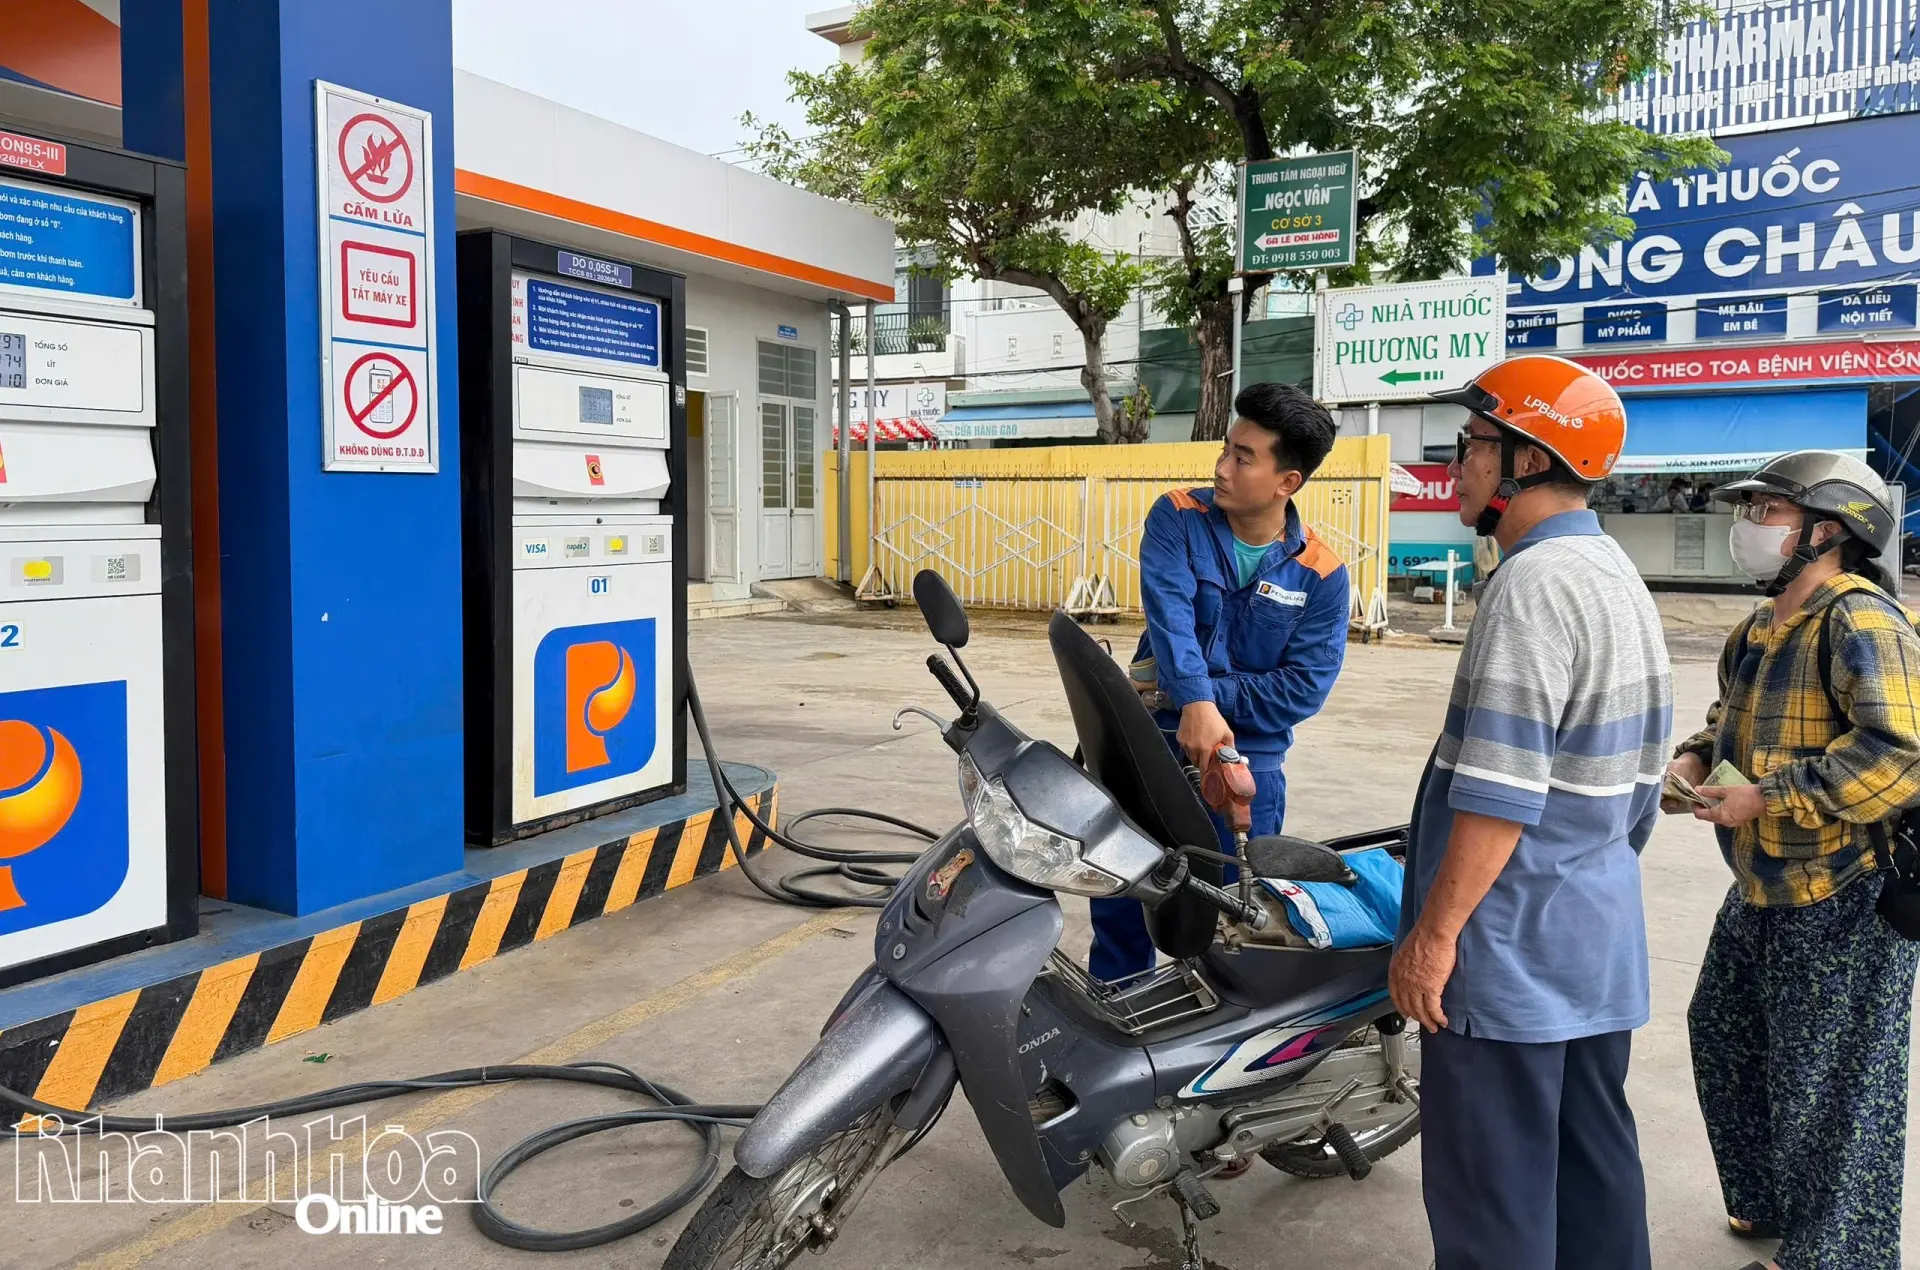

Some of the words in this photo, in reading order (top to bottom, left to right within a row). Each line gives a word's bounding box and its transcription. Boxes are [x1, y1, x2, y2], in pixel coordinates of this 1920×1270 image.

[1666, 15, 1834, 73] PHARMA
[1653, 86, 1722, 116] thuốc
[1794, 64, 1865, 99] ngoại
[0, 137, 58, 160] ON95-III
[1252, 172, 1278, 185] TRUNG
[1280, 169, 1298, 181] TÂM
[1300, 165, 1325, 180] NGOẠI
[1673, 147, 1840, 208] THUỐC
[1265, 190, 1301, 214] NGỌC
[1304, 184, 1330, 206] VÂN
[9, 195, 18, 204] và
[19, 196, 31, 206] xác
[32, 199, 49, 210] nhận
[49, 202, 62, 211] nhu
[63, 203, 75, 214] cầu
[76, 206, 88, 216] của
[89, 209, 107, 219] khách
[107, 211, 125, 224] hàng.
[343, 202, 378, 220] CẤM
[384, 209, 413, 227] LỬA
[0, 211, 15, 222] bơm
[16, 214, 33, 227] đang
[34, 217, 40, 226] ở
[41, 217, 49, 227] số
[1272, 218, 1290, 230] CƠ
[1293, 213, 1312, 228] SỞ
[1315, 215, 1322, 226] 3
[15, 232, 34, 245] hàng.
[1704, 202, 1920, 278] CHÂU
[17, 251, 36, 262] trước
[37, 254, 48, 263] khi
[48, 256, 67, 266] thanh
[68, 260, 84, 268] toán.
[1252, 255, 1269, 265] ĐT:
[1272, 252, 1297, 263] 0918
[1300, 250, 1319, 260] 550
[1321, 248, 1341, 259] 003
[567, 267, 585, 277] TCCS
[572, 256, 587, 269] DO
[588, 260, 620, 277] 0,05S-II
[11, 268, 25, 278] cảm
[26, 271, 36, 279] ơn
[37, 271, 57, 282] khách
[58, 275, 75, 287] hàng.
[360, 268, 378, 283] YÊU
[381, 270, 399, 286] CẦU
[352, 284, 370, 300] TẮT
[373, 290, 393, 304] MÁY
[396, 295, 407, 306] XE
[1372, 298, 1414, 323] NHÀ
[1419, 290, 1491, 319] THUỐC
[1517, 315, 1543, 328] THIẾT
[1723, 322, 1740, 331] EM
[1743, 318, 1758, 330] BÉ
[1841, 313, 1865, 325] NỘI
[1868, 308, 1893, 321] TIẾT
[1618, 322, 1651, 337] PHẨM
[0, 334, 21, 349] 97
[34, 340, 56, 350] TỔNG
[58, 342, 68, 351] SỐ
[1335, 335, 1438, 365] PHƯƠNG
[1449, 332, 1490, 358] MY
[0, 353, 22, 368] 74
[1650, 362, 1702, 378] THEO
[1709, 360, 1751, 375] TOA
[1758, 354, 1812, 376] BỆNH
[1820, 350, 1869, 373] VIỆN
[1876, 345, 1920, 368] LỚN
[36, 377, 53, 386] ĐƠN
[54, 378, 69, 386] GIÁ
[1523, 395, 1570, 427] LPBank
[339, 443, 369, 456] KHÔNG
[371, 444, 394, 456] DÙNG
[1406, 478, 1456, 500] HƯ
[525, 543, 547, 554] VISA
[591, 578, 607, 593] 01
[1017, 1027, 1061, 1055] ONDA
